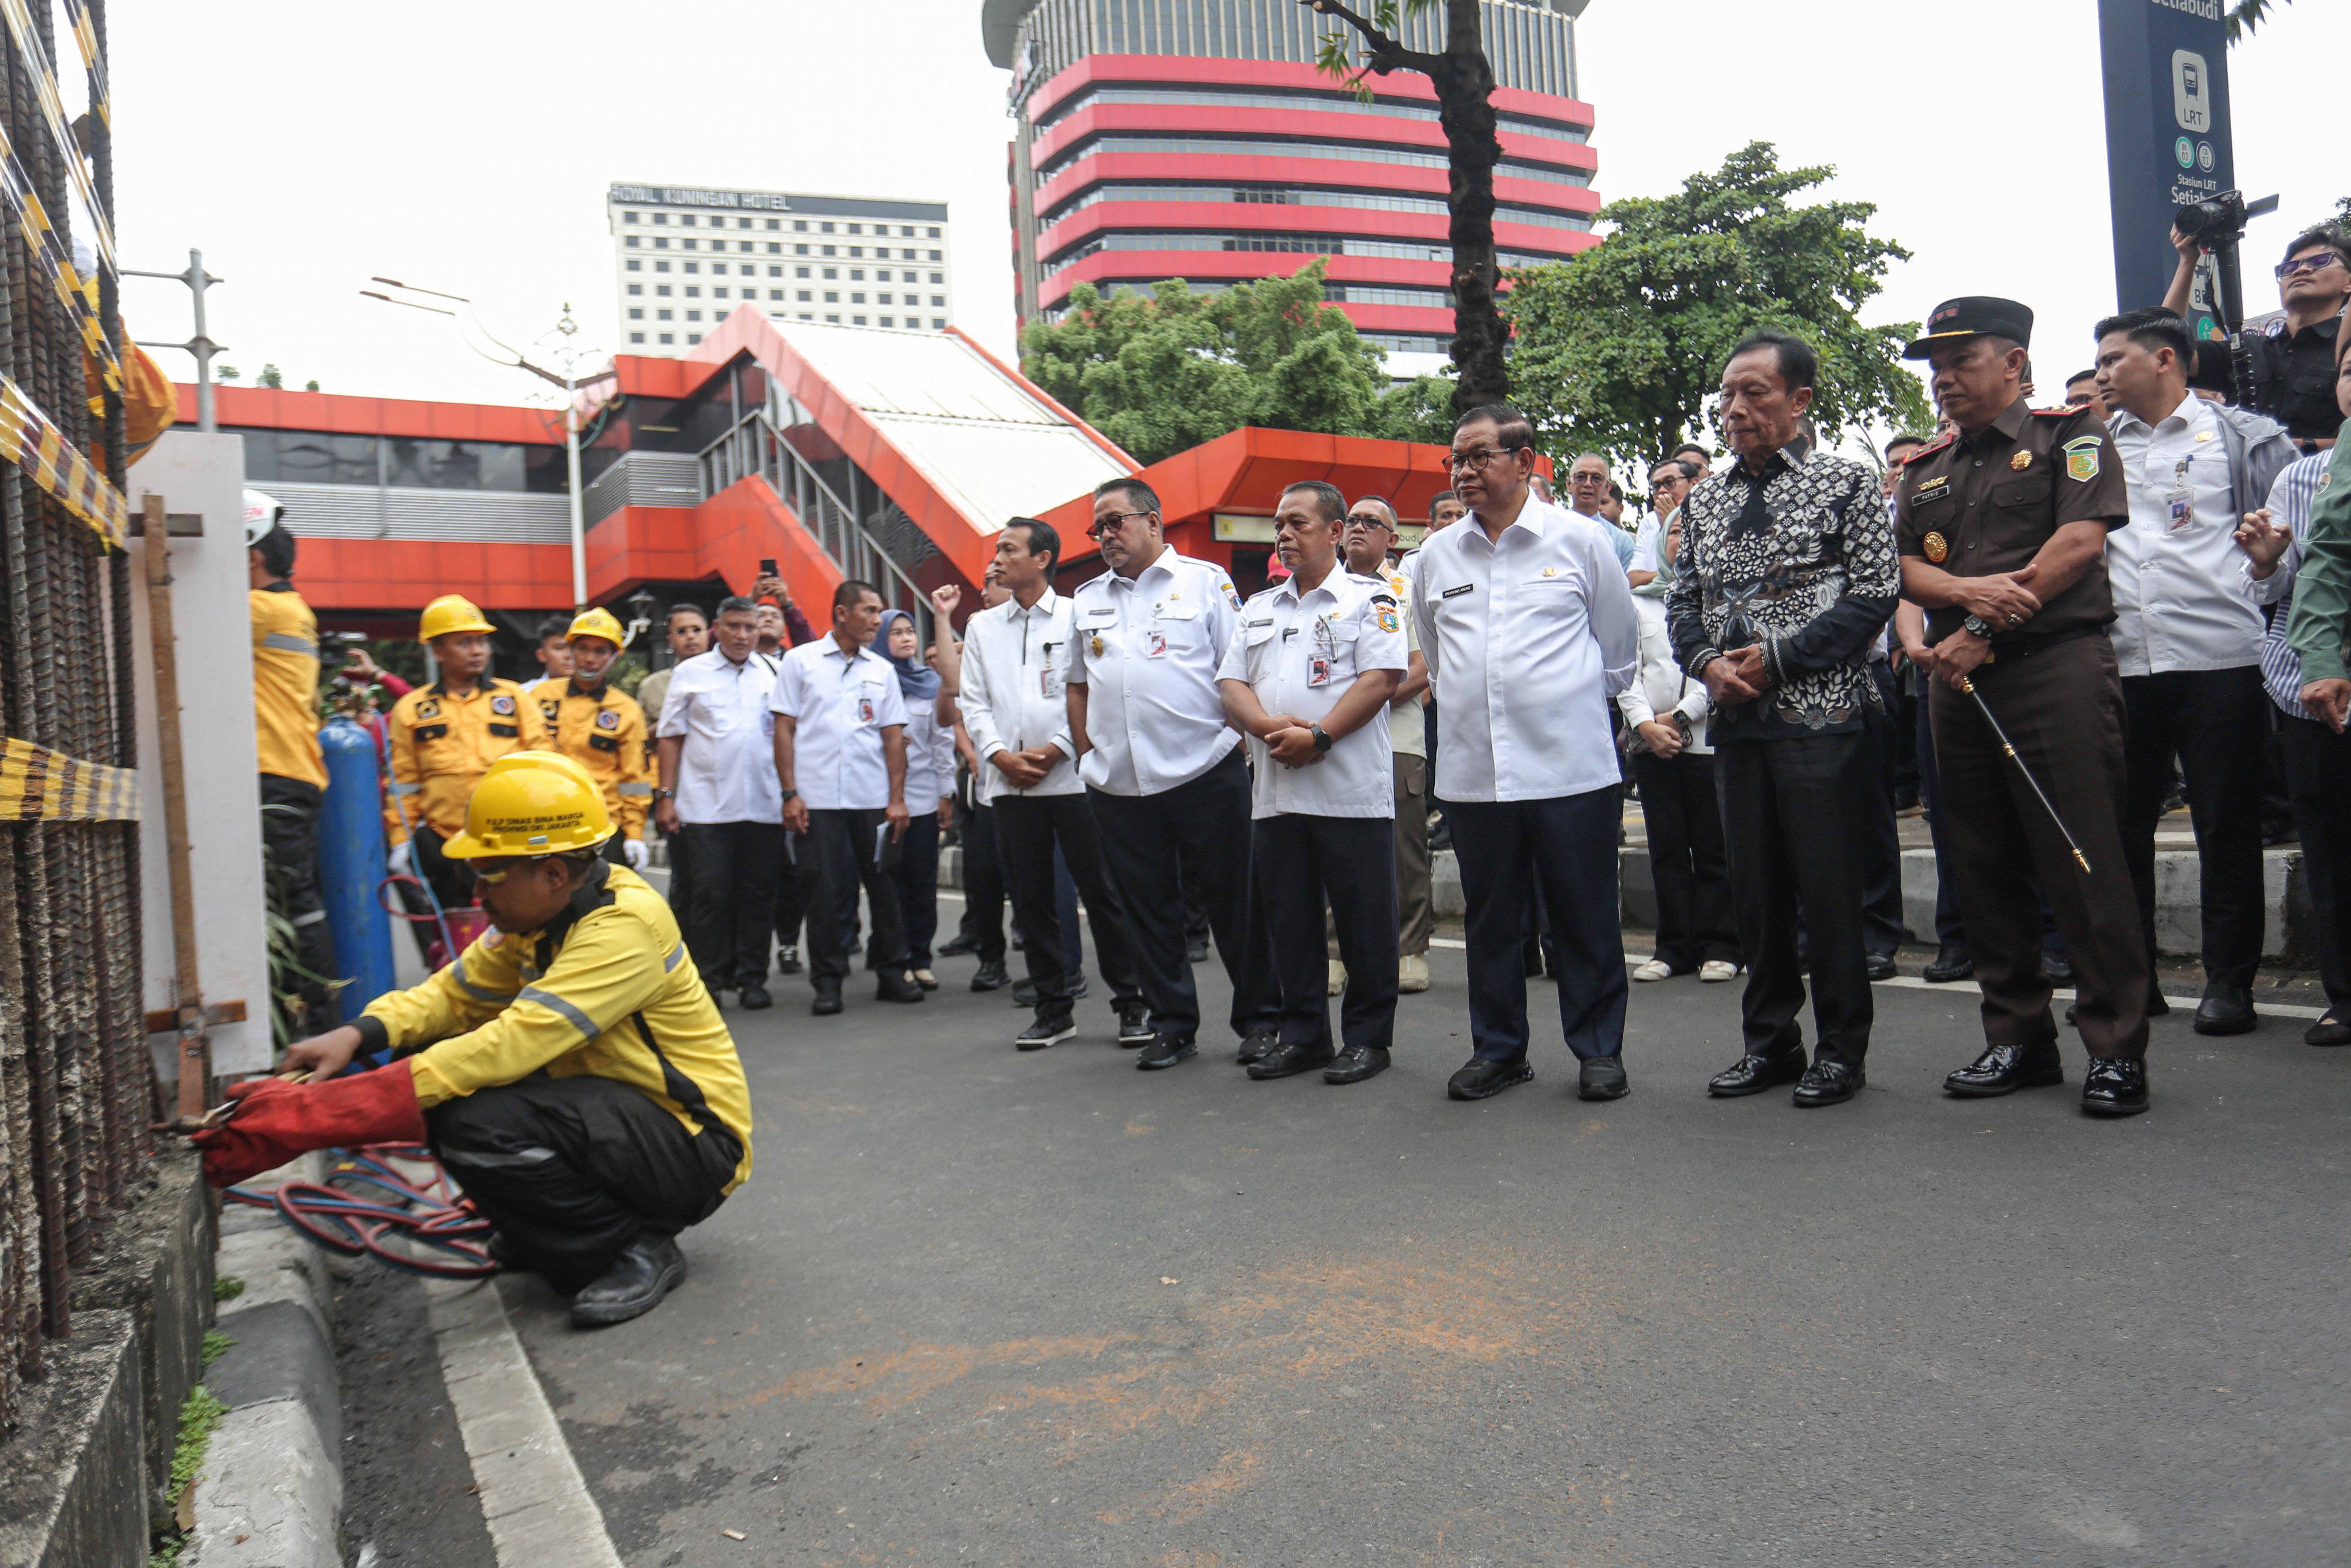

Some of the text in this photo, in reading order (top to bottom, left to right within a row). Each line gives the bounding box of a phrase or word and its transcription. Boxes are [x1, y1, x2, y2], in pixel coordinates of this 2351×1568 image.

[2152, 0, 2217, 20] iabudi
[2184, 109, 2202, 125] LRT
[2182, 151, 2188, 160] 02
[2202, 156, 2208, 165] 02
[2177, 174, 2216, 191] Stasiun LRT
[741, 193, 792, 210] HOTEL
[2172, 186, 2205, 205] Setiab
